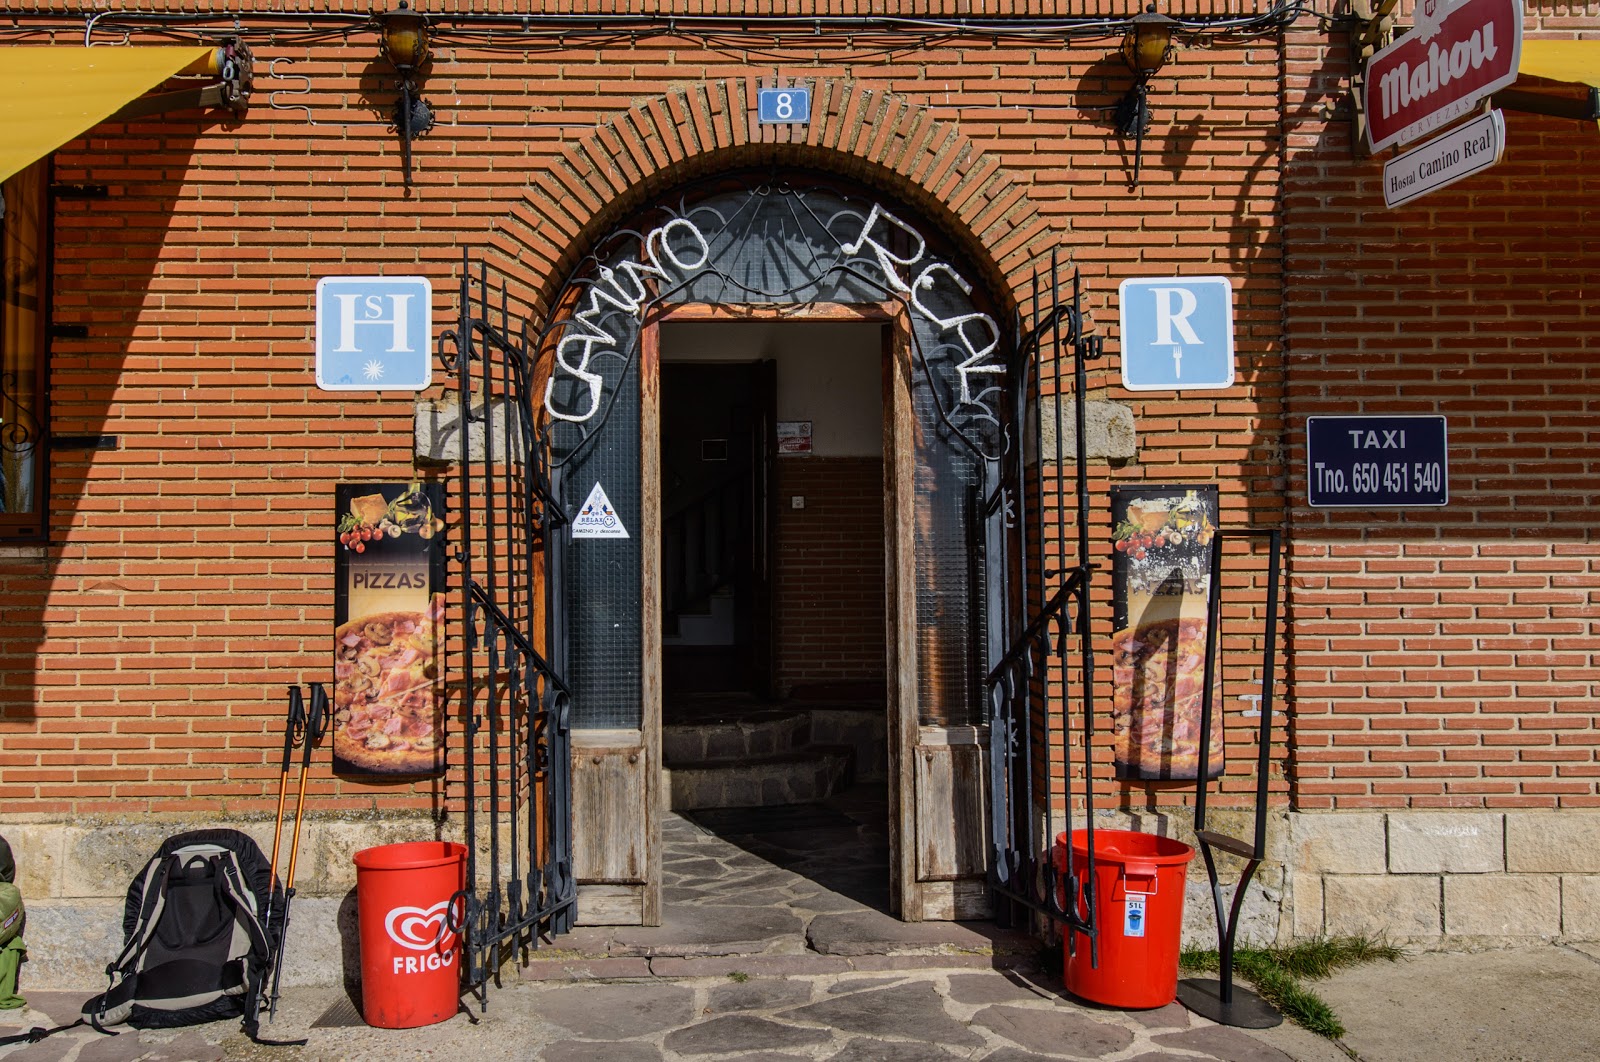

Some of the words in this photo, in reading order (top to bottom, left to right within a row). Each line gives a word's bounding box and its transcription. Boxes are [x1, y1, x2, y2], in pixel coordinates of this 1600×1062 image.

[1379, 21, 1498, 120] Mahou
[776, 93, 793, 119] 8
[1400, 98, 1469, 141] CERVEZAS
[1390, 171, 1416, 193] Hostal
[1418, 151, 1460, 180] Camino
[1463, 129, 1491, 160] Real
[1148, 287, 1204, 345] R
[1348, 430, 1405, 448] TAXI
[1314, 462, 1348, 493] Tno.
[1352, 462, 1379, 493] 650
[1383, 462, 1408, 493] 451
[1413, 462, 1441, 493] 540
[393, 948, 454, 975] FRIGO
